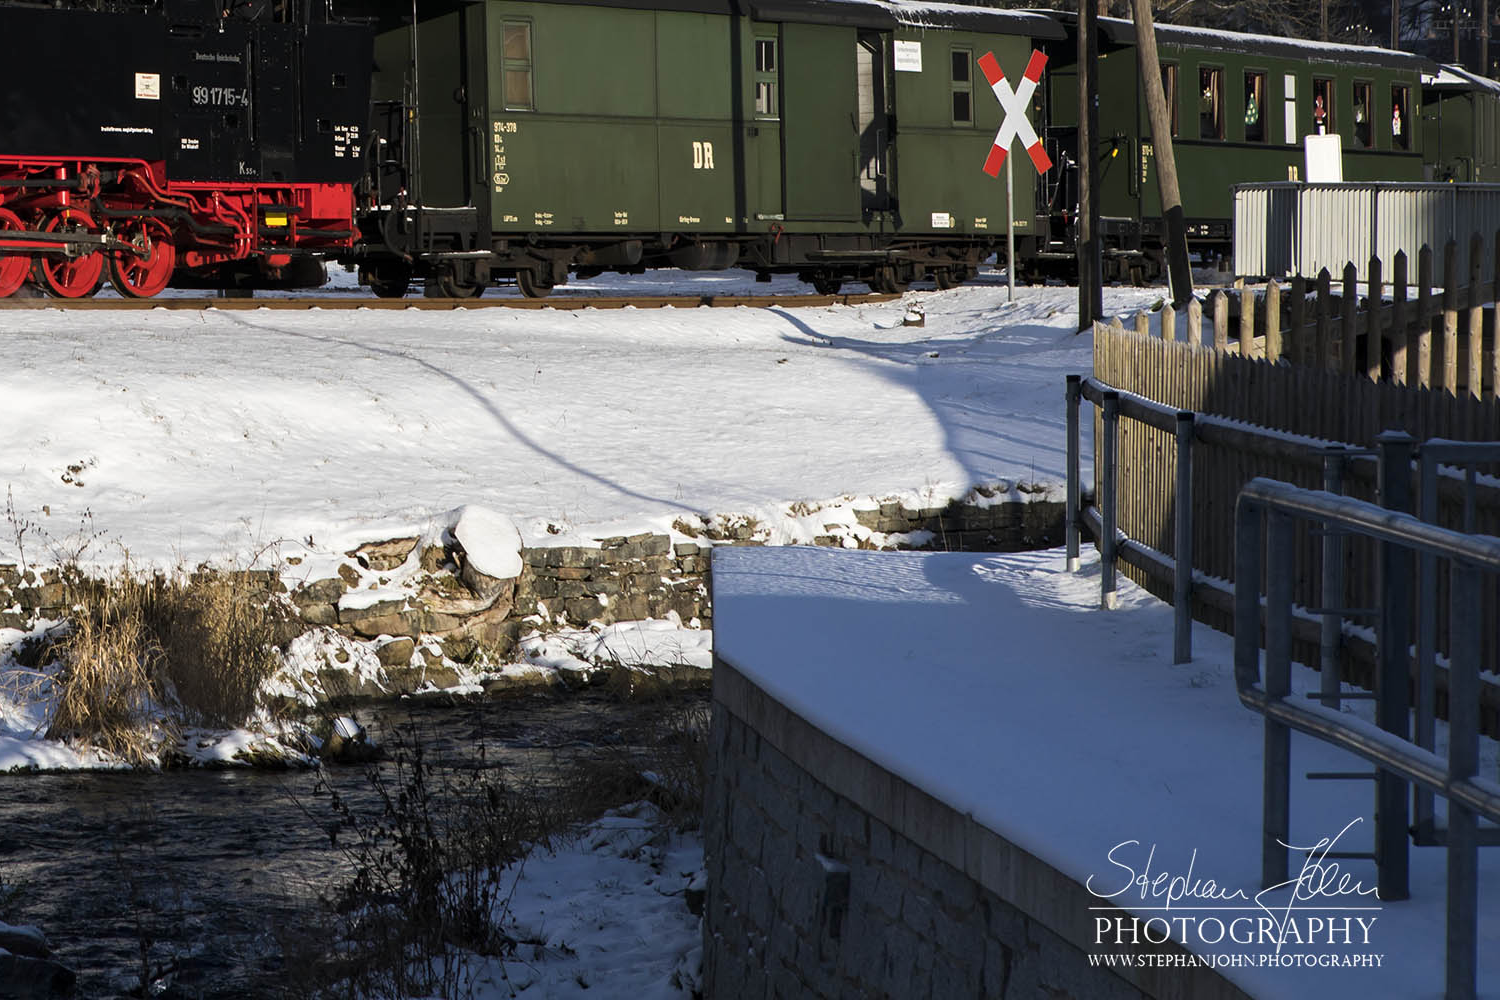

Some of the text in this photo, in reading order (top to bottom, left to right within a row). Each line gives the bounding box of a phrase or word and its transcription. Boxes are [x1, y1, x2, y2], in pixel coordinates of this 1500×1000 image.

[193, 87, 249, 106] 99 1715-4
[692, 141, 715, 169] DR
